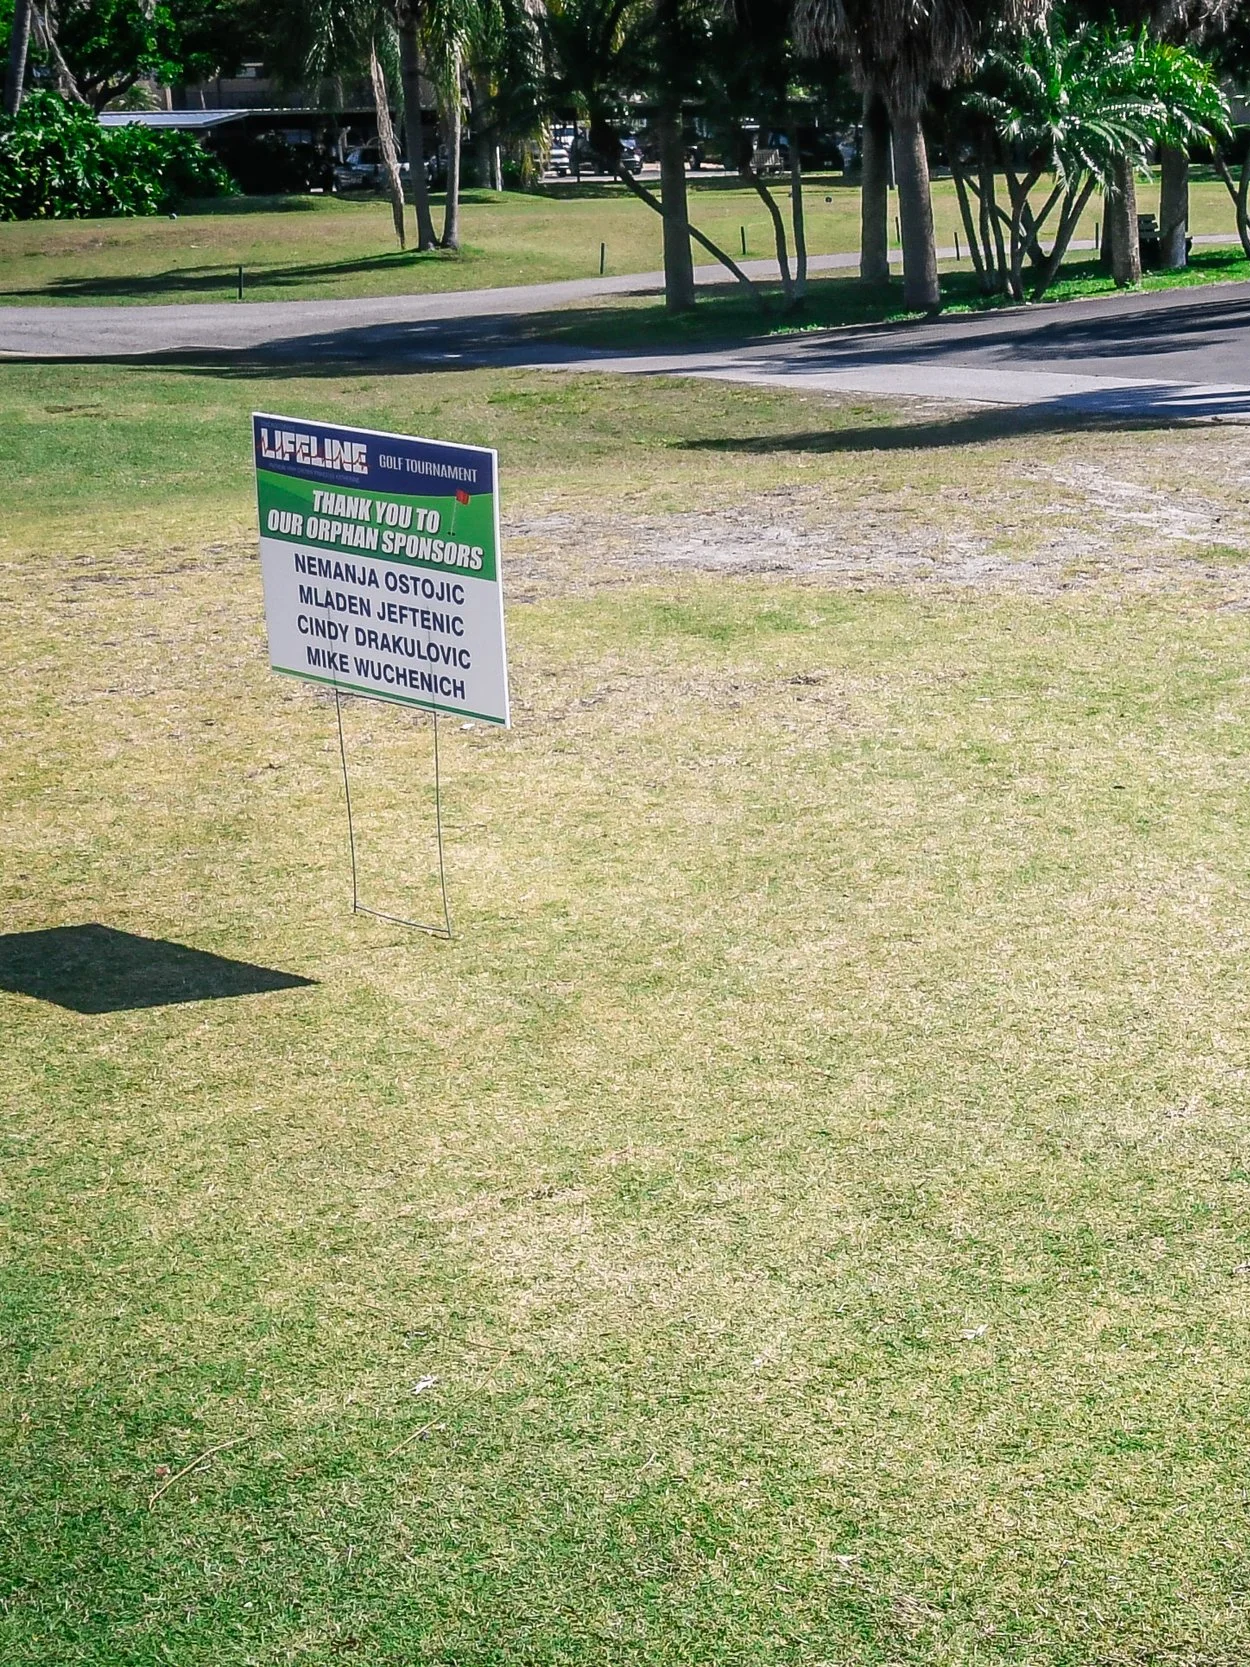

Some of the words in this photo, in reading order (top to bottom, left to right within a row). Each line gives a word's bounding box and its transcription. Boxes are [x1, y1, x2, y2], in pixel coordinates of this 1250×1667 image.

[261, 428, 368, 475] LIFELINE
[379, 454, 404, 471] GOLF
[405, 458, 478, 483] TOURNAMENT
[312, 490, 372, 521] THANK
[375, 500, 412, 529] YOU
[416, 508, 440, 534] TO
[267, 509, 303, 536] OUR
[306, 517, 379, 551] ORPHAN
[381, 531, 484, 570] SPONSORS
[294, 553, 379, 588] NEMANJA
[384, 571, 465, 605] OSTOJIC
[299, 584, 371, 618] MLADEN
[377, 601, 464, 636] JEFTENIC
[297, 614, 349, 643] CINDY
[355, 627, 471, 670] DRAKULOVIC
[306, 646, 350, 674] MIKE
[353, 656, 465, 700] WUCHENICH
